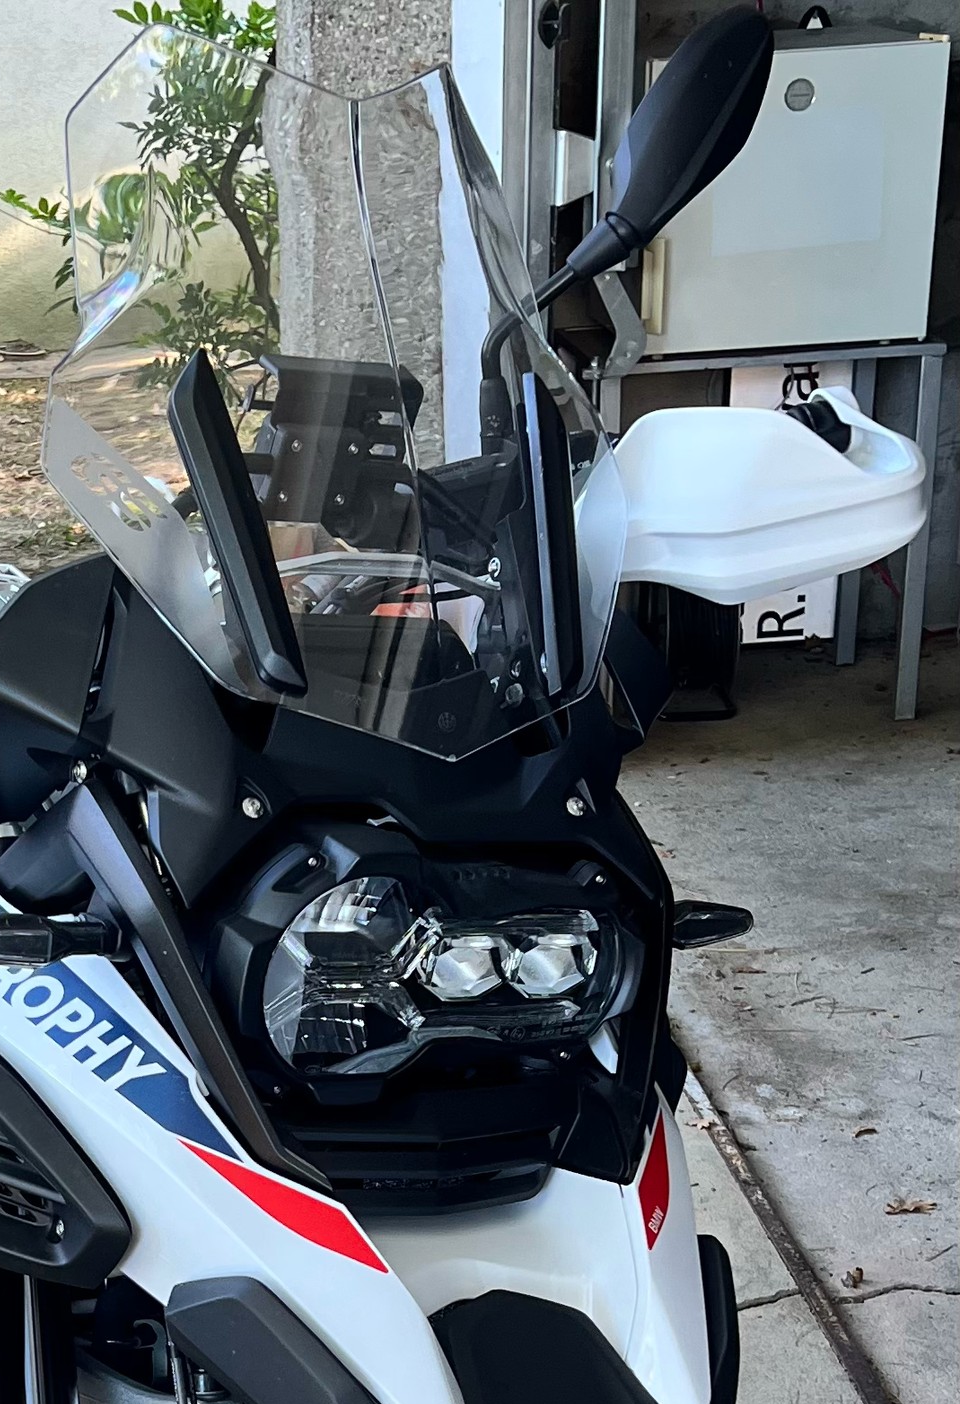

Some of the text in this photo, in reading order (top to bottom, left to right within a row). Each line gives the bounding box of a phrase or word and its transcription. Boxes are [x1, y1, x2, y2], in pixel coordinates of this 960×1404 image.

[70, 453, 168, 532] GS
[756, 594, 806, 639] R.
[647, 1205, 665, 1234] BMW
